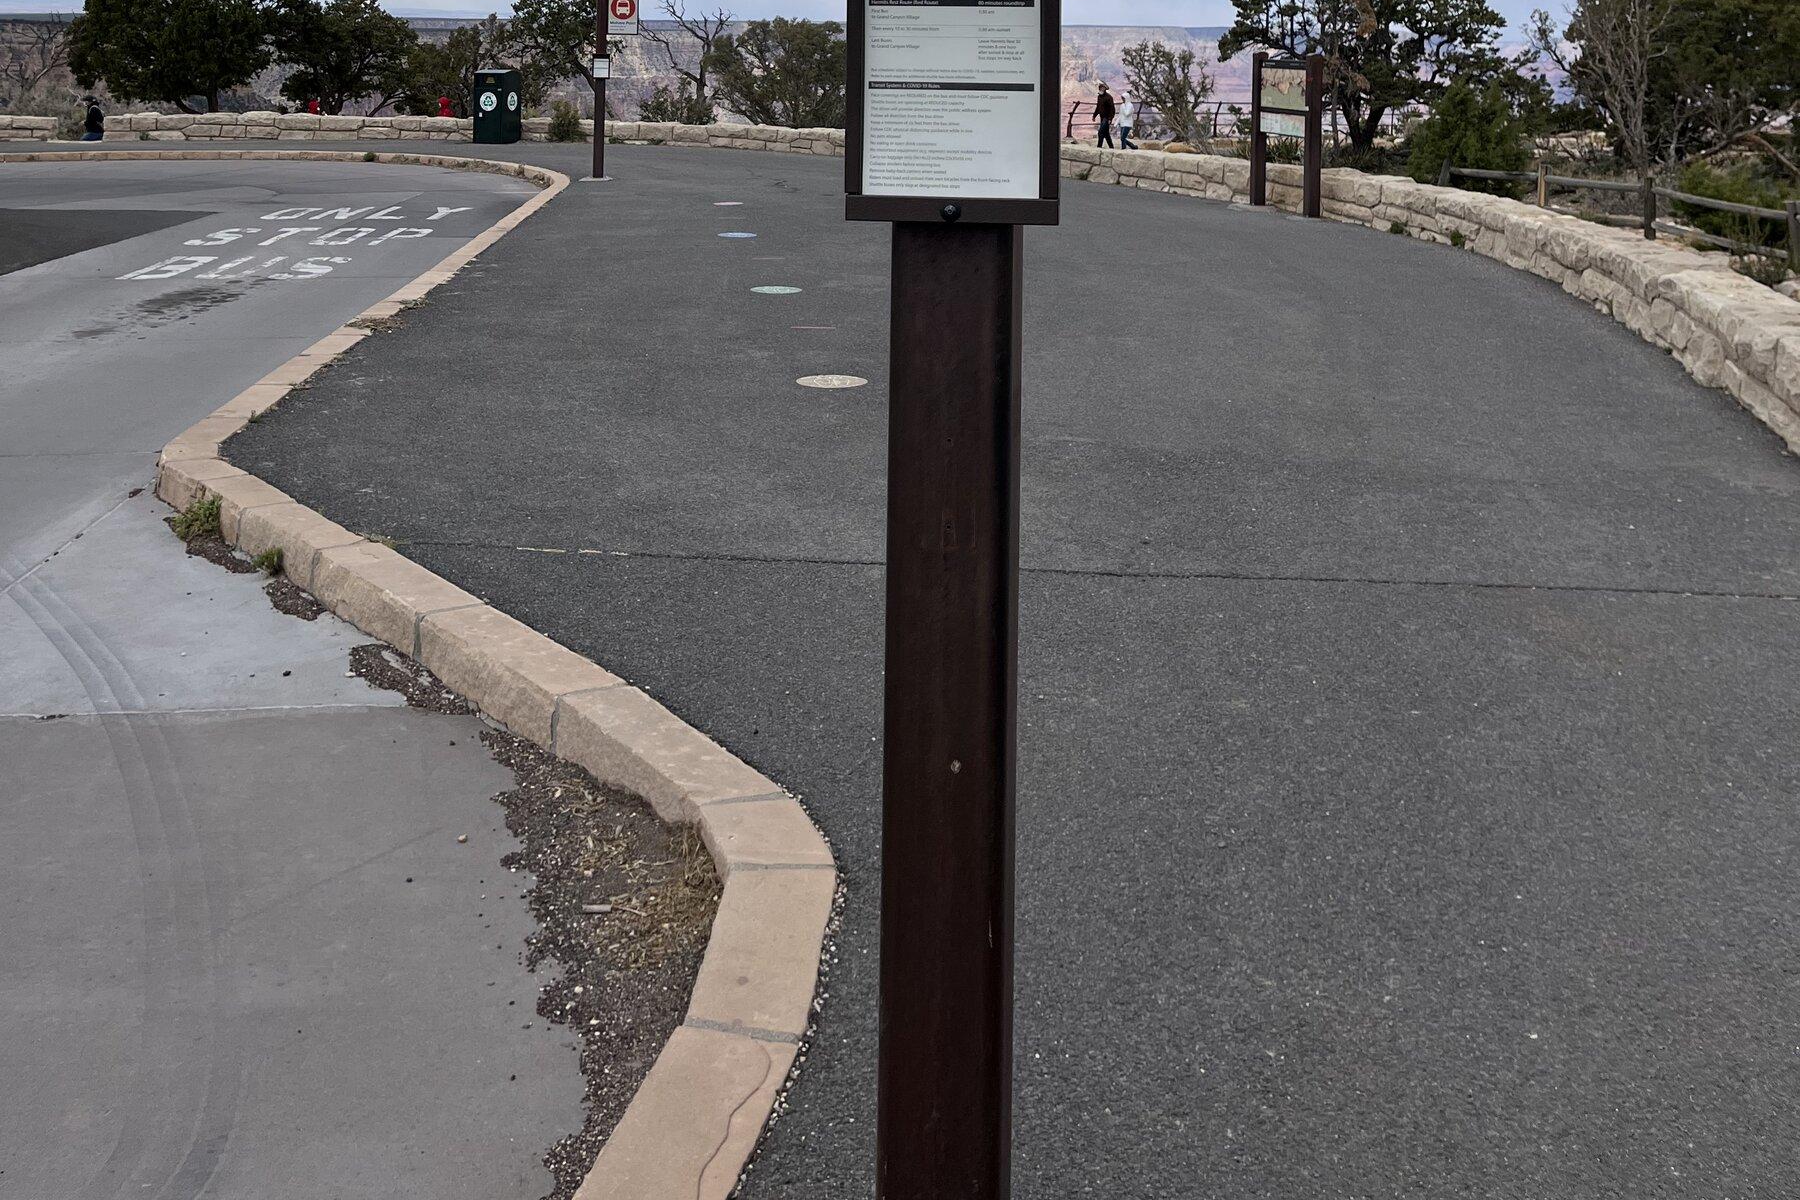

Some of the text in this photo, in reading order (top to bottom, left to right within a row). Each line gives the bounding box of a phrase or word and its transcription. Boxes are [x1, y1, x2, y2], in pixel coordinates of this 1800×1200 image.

[260, 205, 474, 220] ONLY
[183, 227, 434, 247] STOP
[115, 256, 352, 281] BUS
